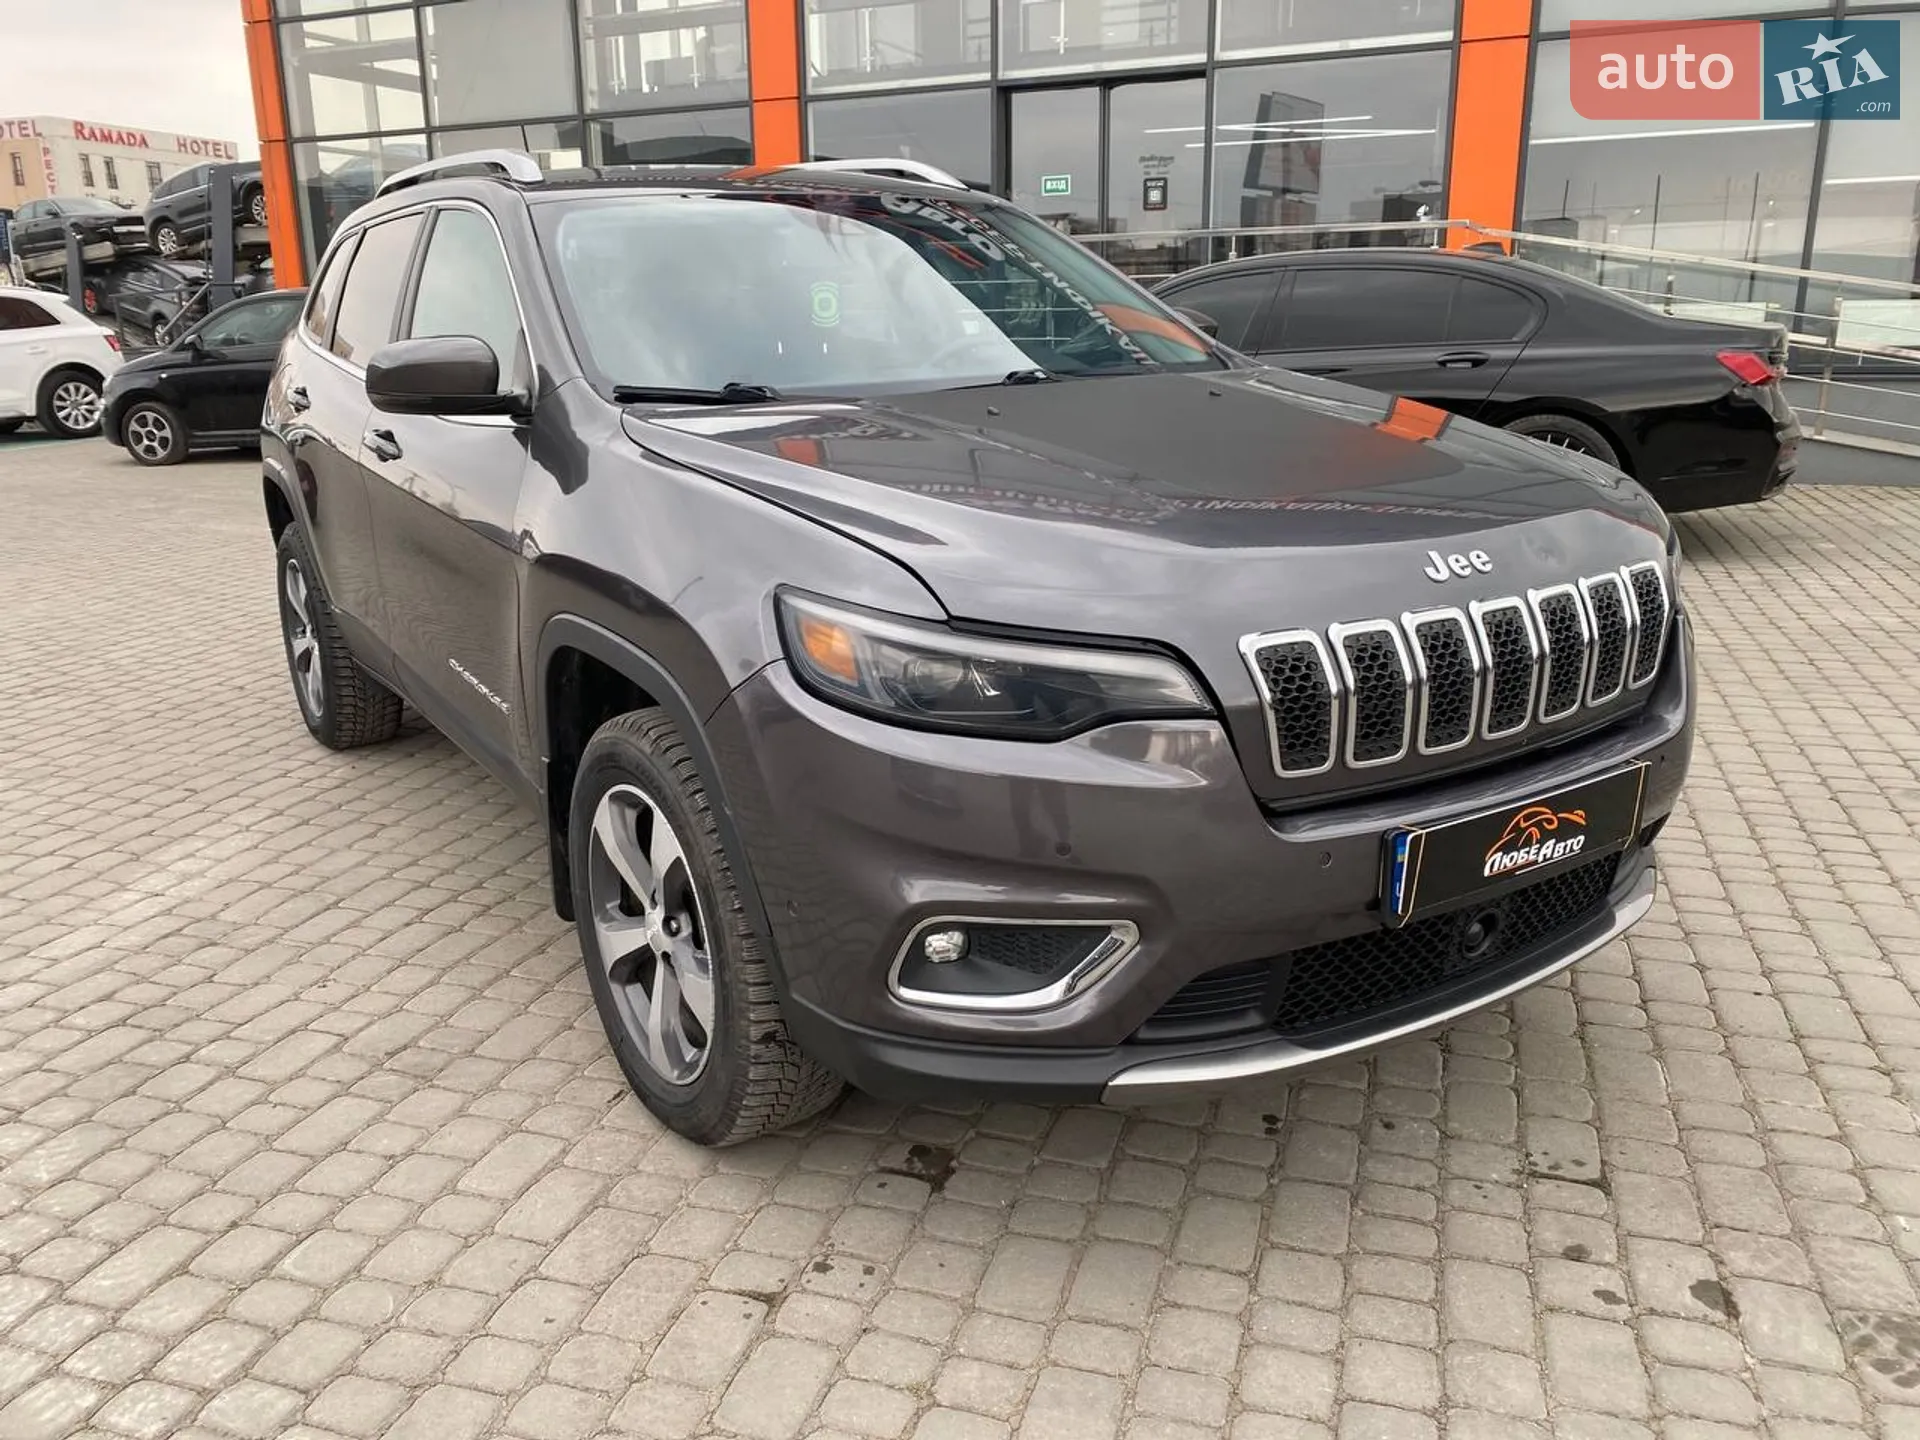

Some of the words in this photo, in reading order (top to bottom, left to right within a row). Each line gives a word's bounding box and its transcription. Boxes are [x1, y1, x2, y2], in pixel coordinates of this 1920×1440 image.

[73, 120, 150, 149] RAMADA
[176, 135, 234, 160] HOTEL
[1423, 550, 1493, 582] Jee
